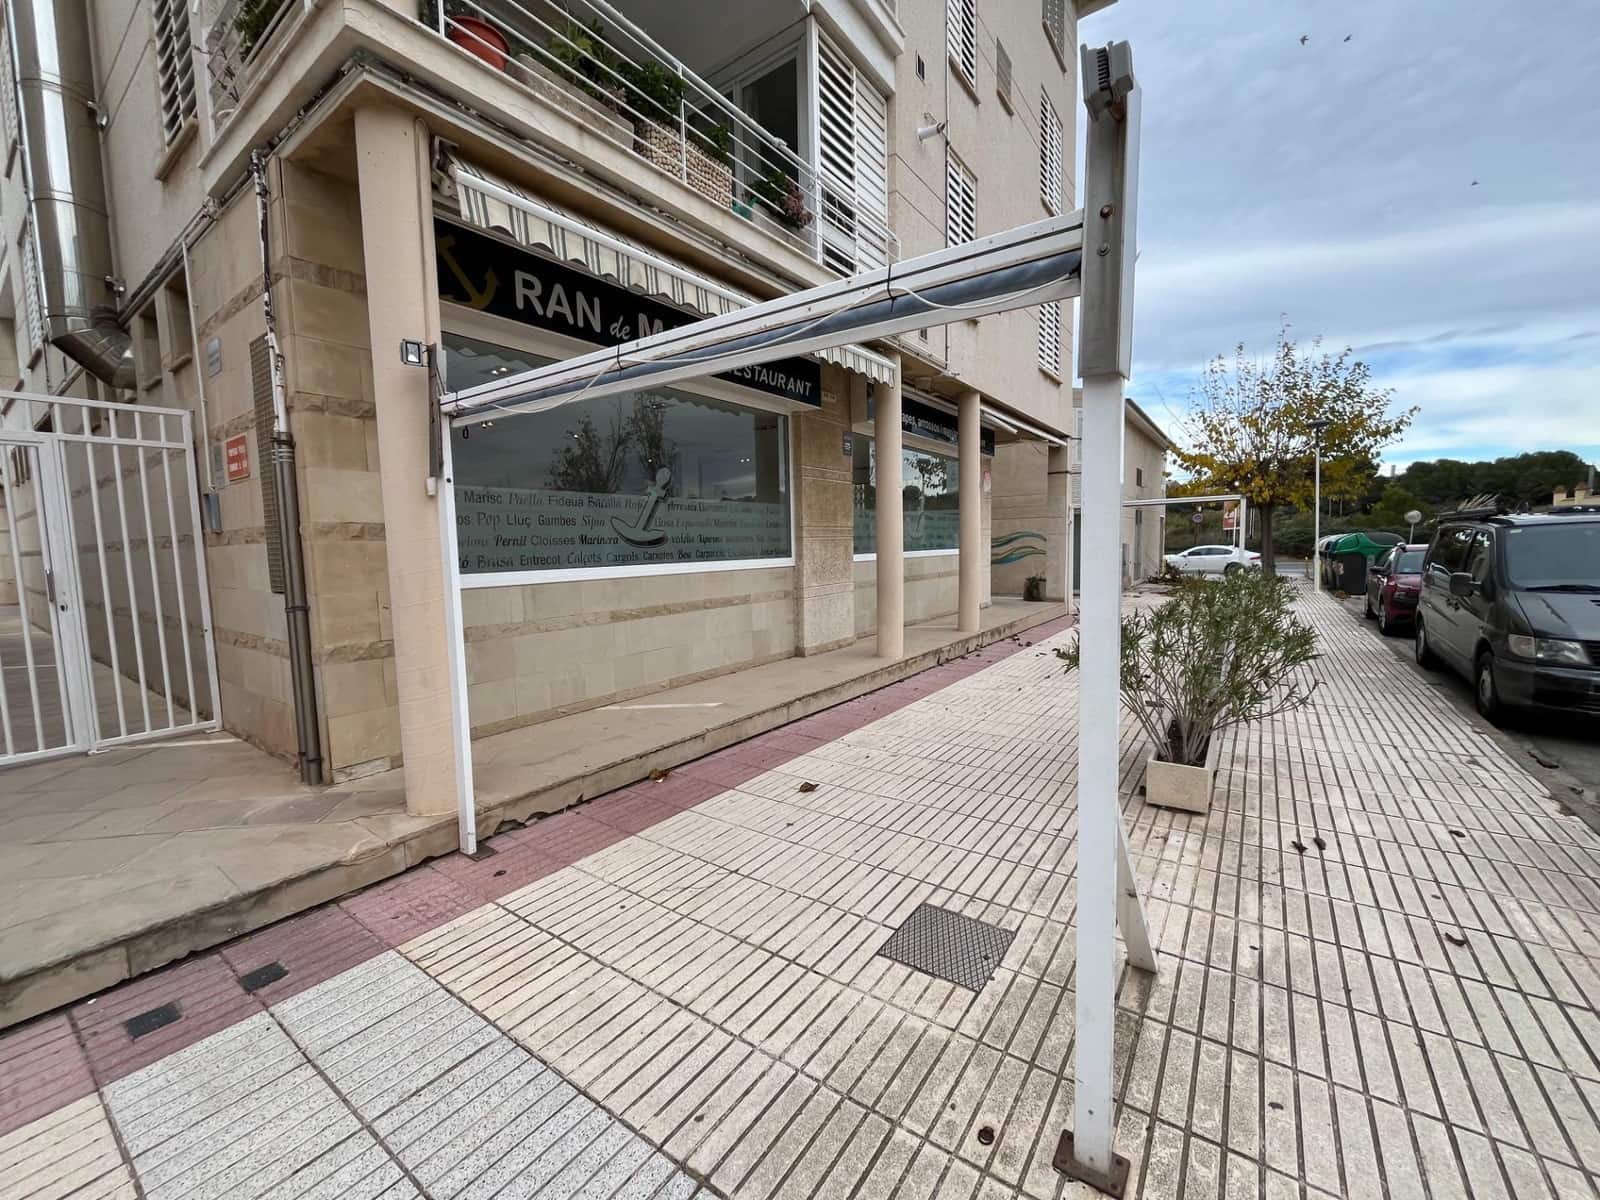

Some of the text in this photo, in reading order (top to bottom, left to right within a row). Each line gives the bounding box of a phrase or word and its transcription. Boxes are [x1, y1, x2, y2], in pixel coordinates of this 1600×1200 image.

[514, 269, 601, 333] RAN
[609, 315, 631, 340] de
[464, 490, 503, 504] Marisc
[538, 514, 577, 527] Gambes
[520, 554, 561, 566] Entrecot
